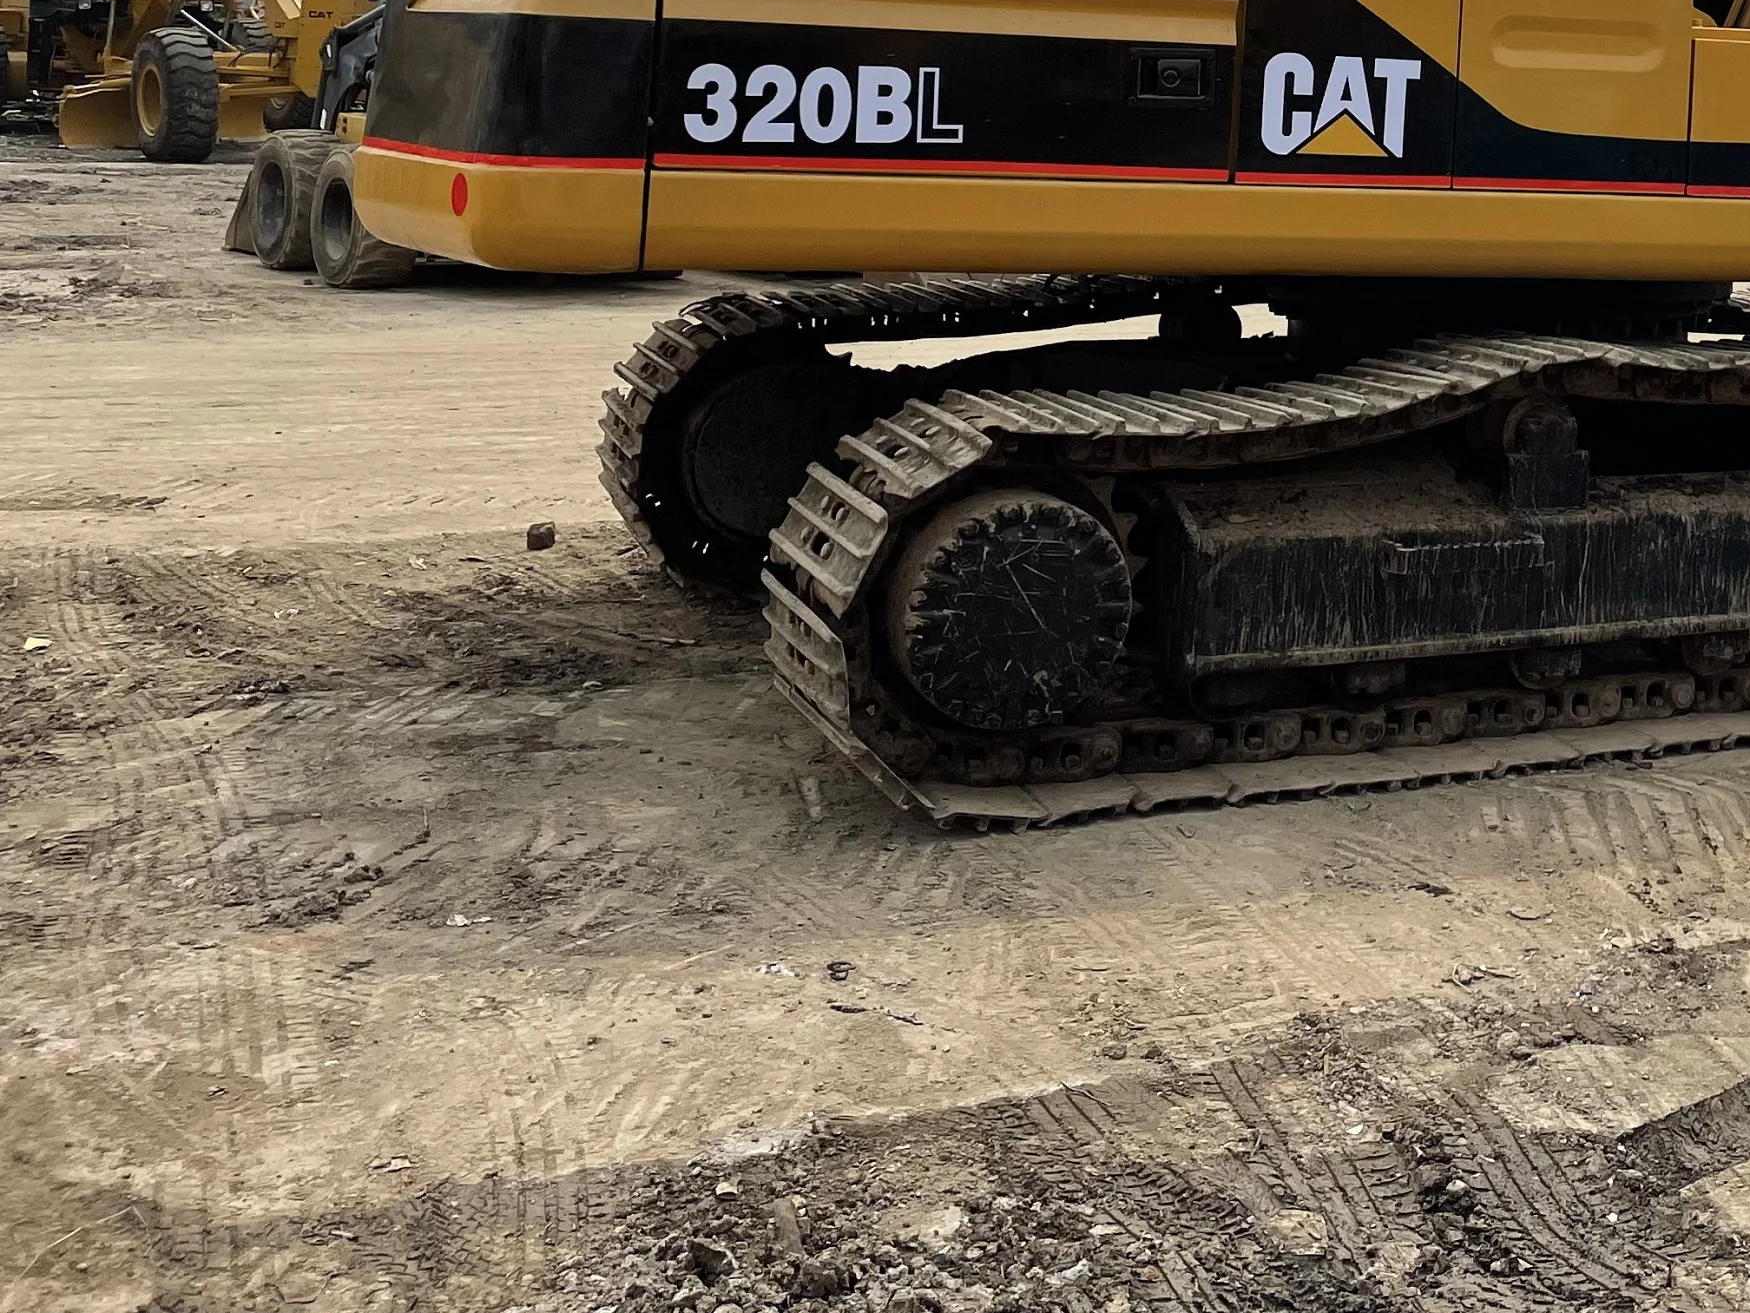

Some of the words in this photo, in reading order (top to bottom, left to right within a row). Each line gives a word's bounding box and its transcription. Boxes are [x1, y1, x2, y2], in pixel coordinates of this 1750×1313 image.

[308, 10, 334, 19] CAT
[683, 62, 964, 144] 320BL
[1260, 51, 1422, 159] CAT
